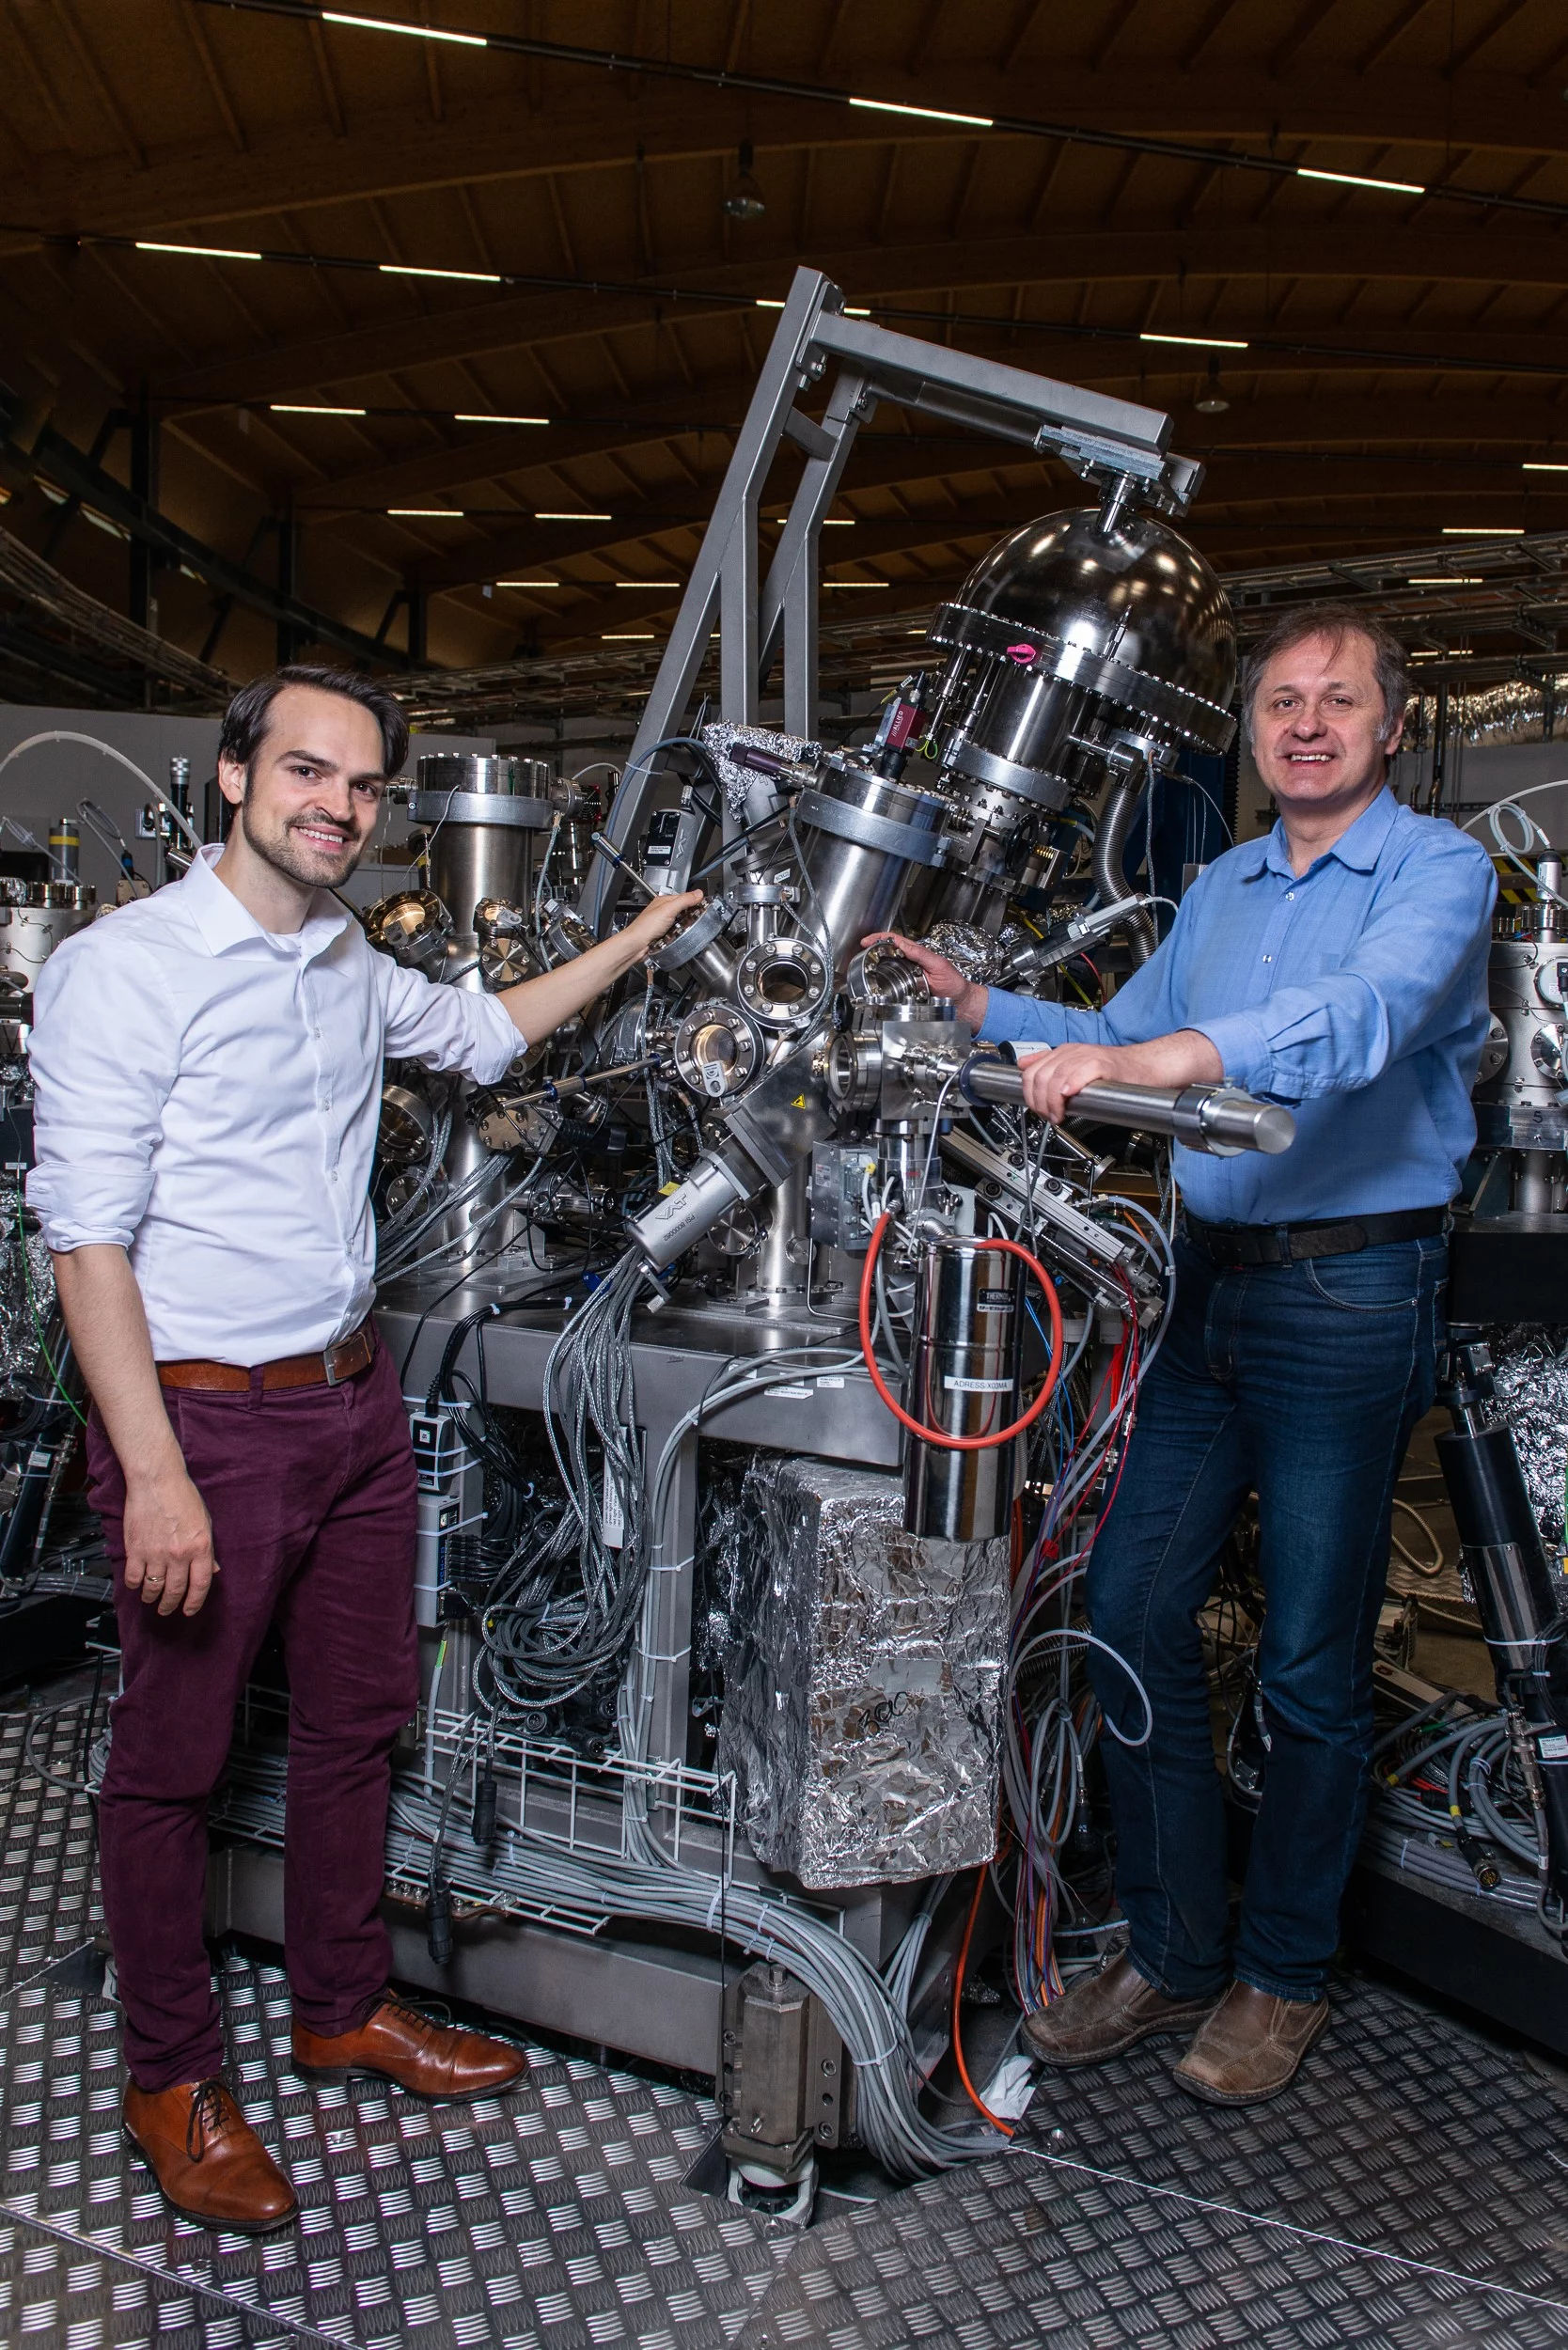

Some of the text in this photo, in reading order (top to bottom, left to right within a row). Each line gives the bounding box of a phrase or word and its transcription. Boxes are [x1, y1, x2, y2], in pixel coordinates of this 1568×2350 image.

[1532, 1110, 1544, 1123] 5
[654, 1193, 687, 1220] VAT
[684, 1214, 696, 1225] PSI
